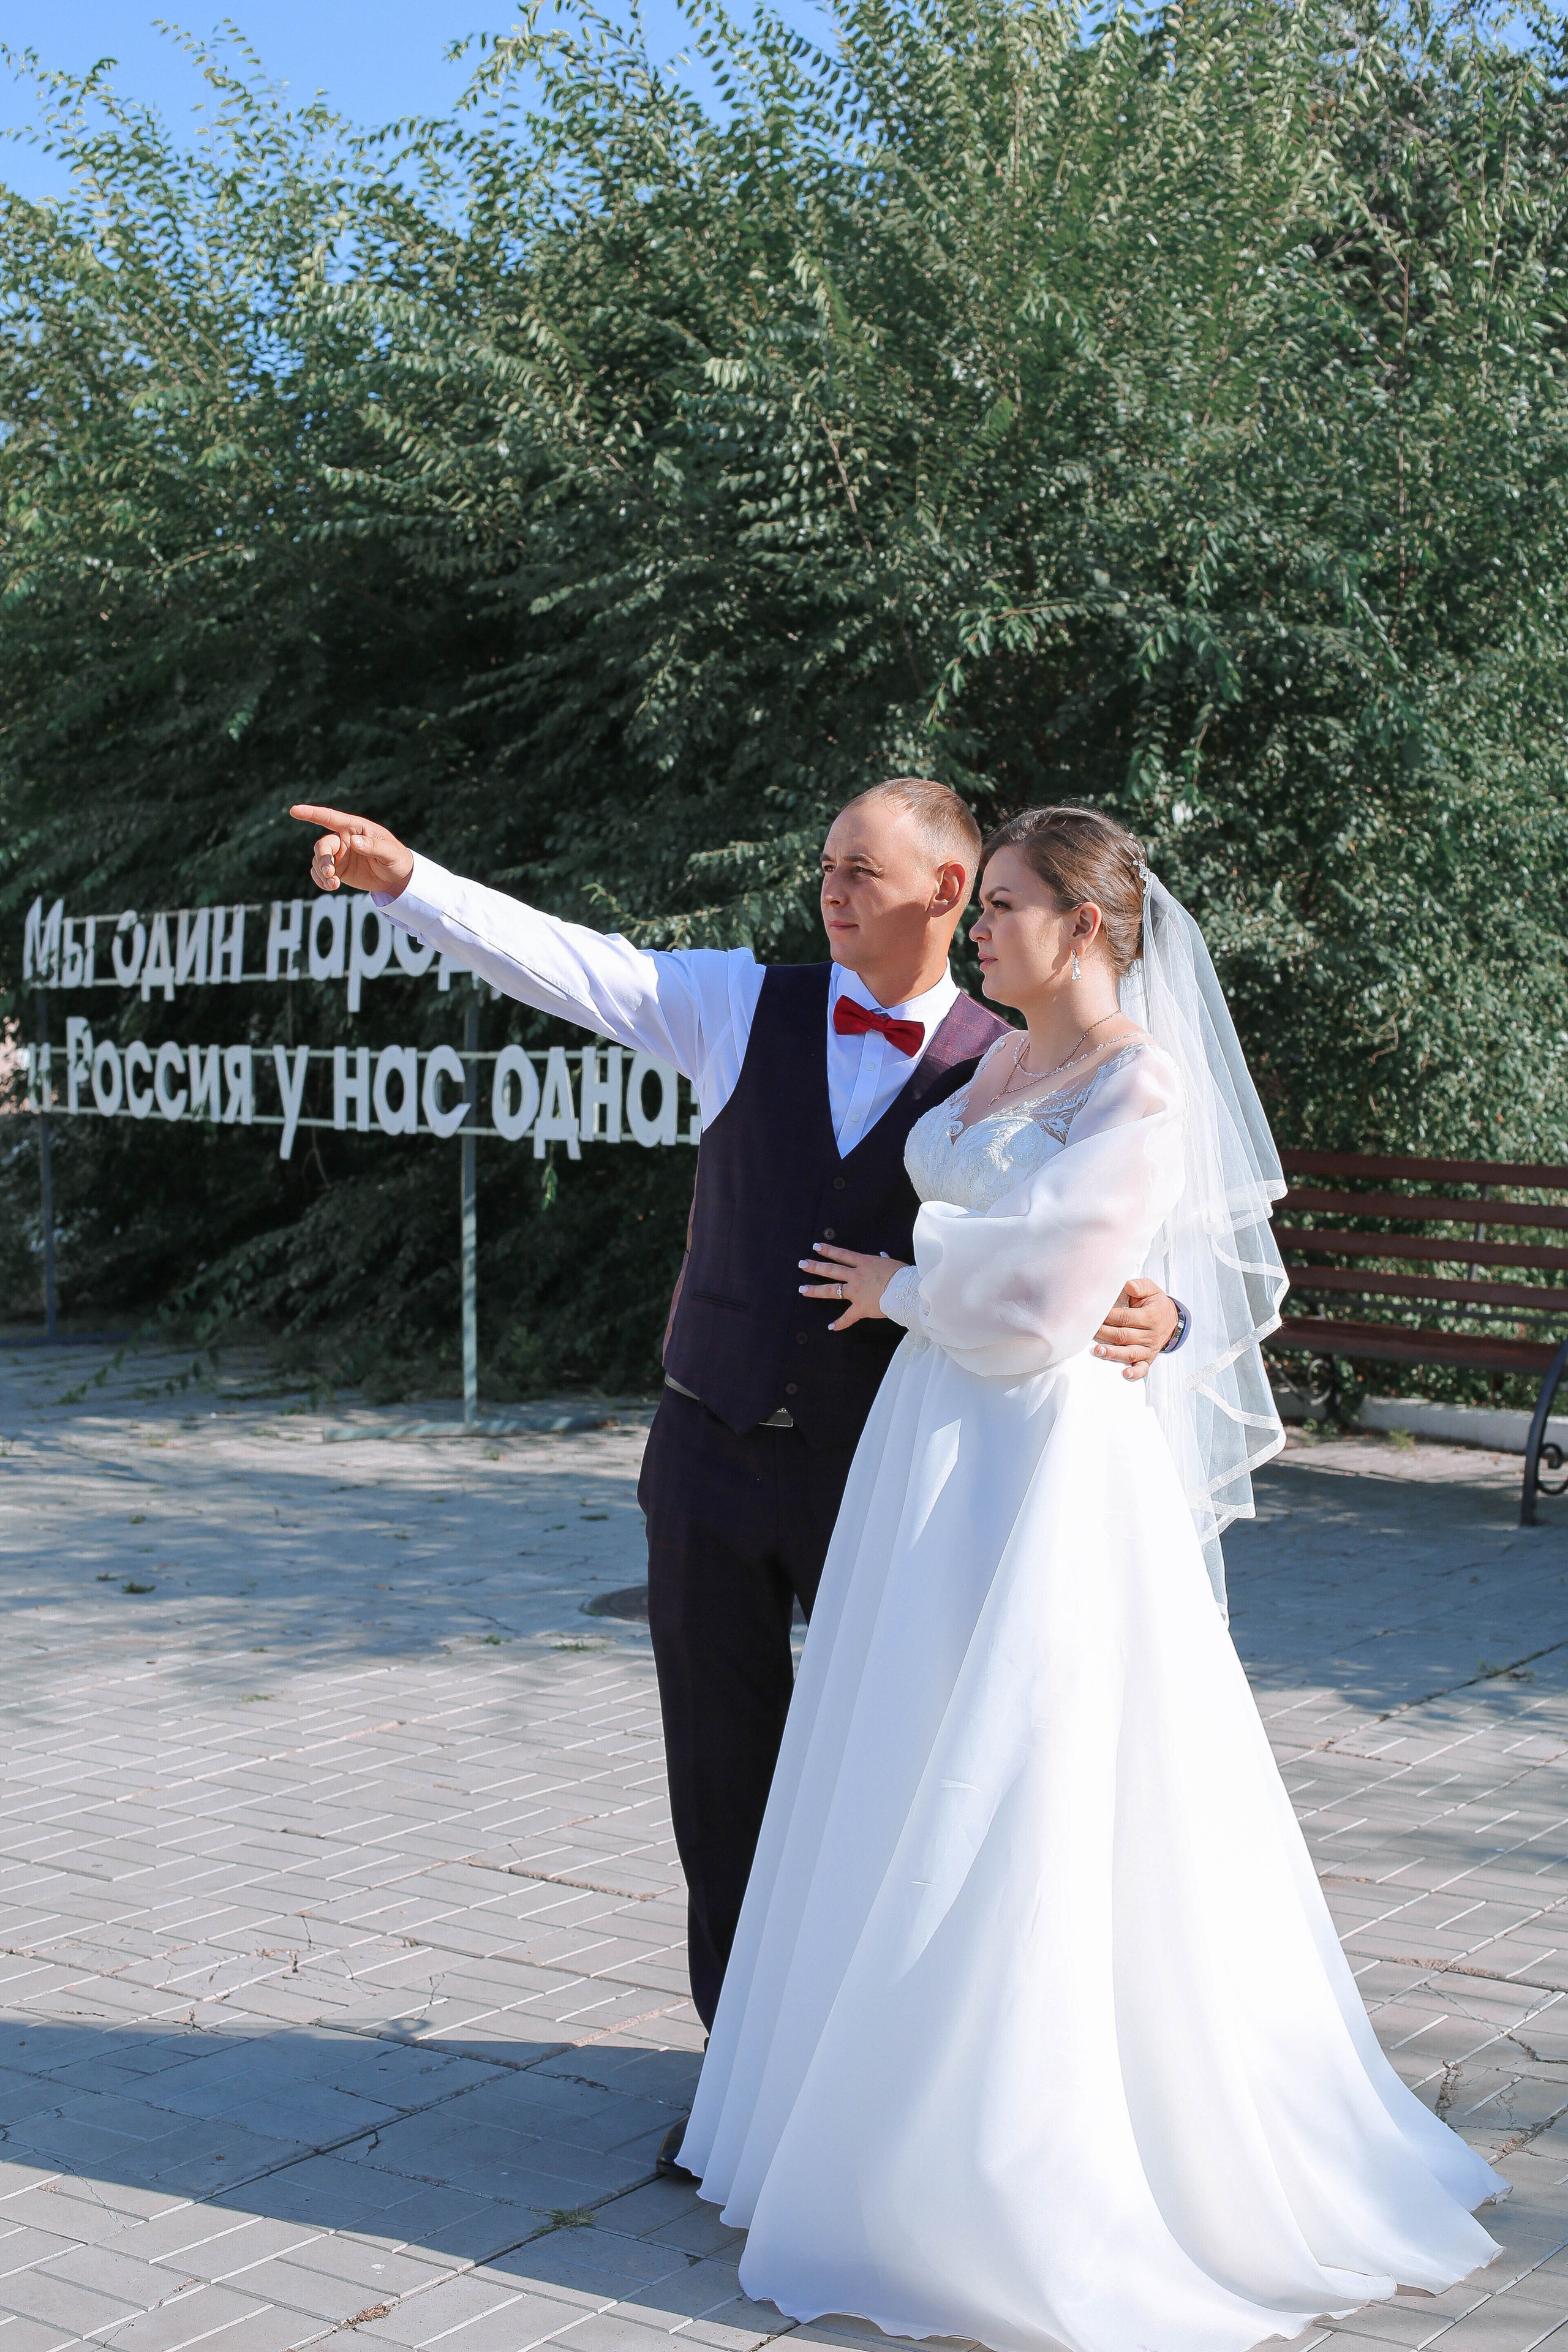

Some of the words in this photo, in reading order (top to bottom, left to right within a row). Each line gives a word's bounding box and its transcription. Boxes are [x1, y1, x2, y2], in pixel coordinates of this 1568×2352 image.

[23, 895, 96, 989] Мы
[111, 905, 245, 1002] один
[266, 893, 502, 1012] нар
[66, 1016, 253, 1125] Россия
[273, 1045, 309, 1159] у
[333, 1045, 470, 1138] нас
[492, 1045, 702, 1159] одна
